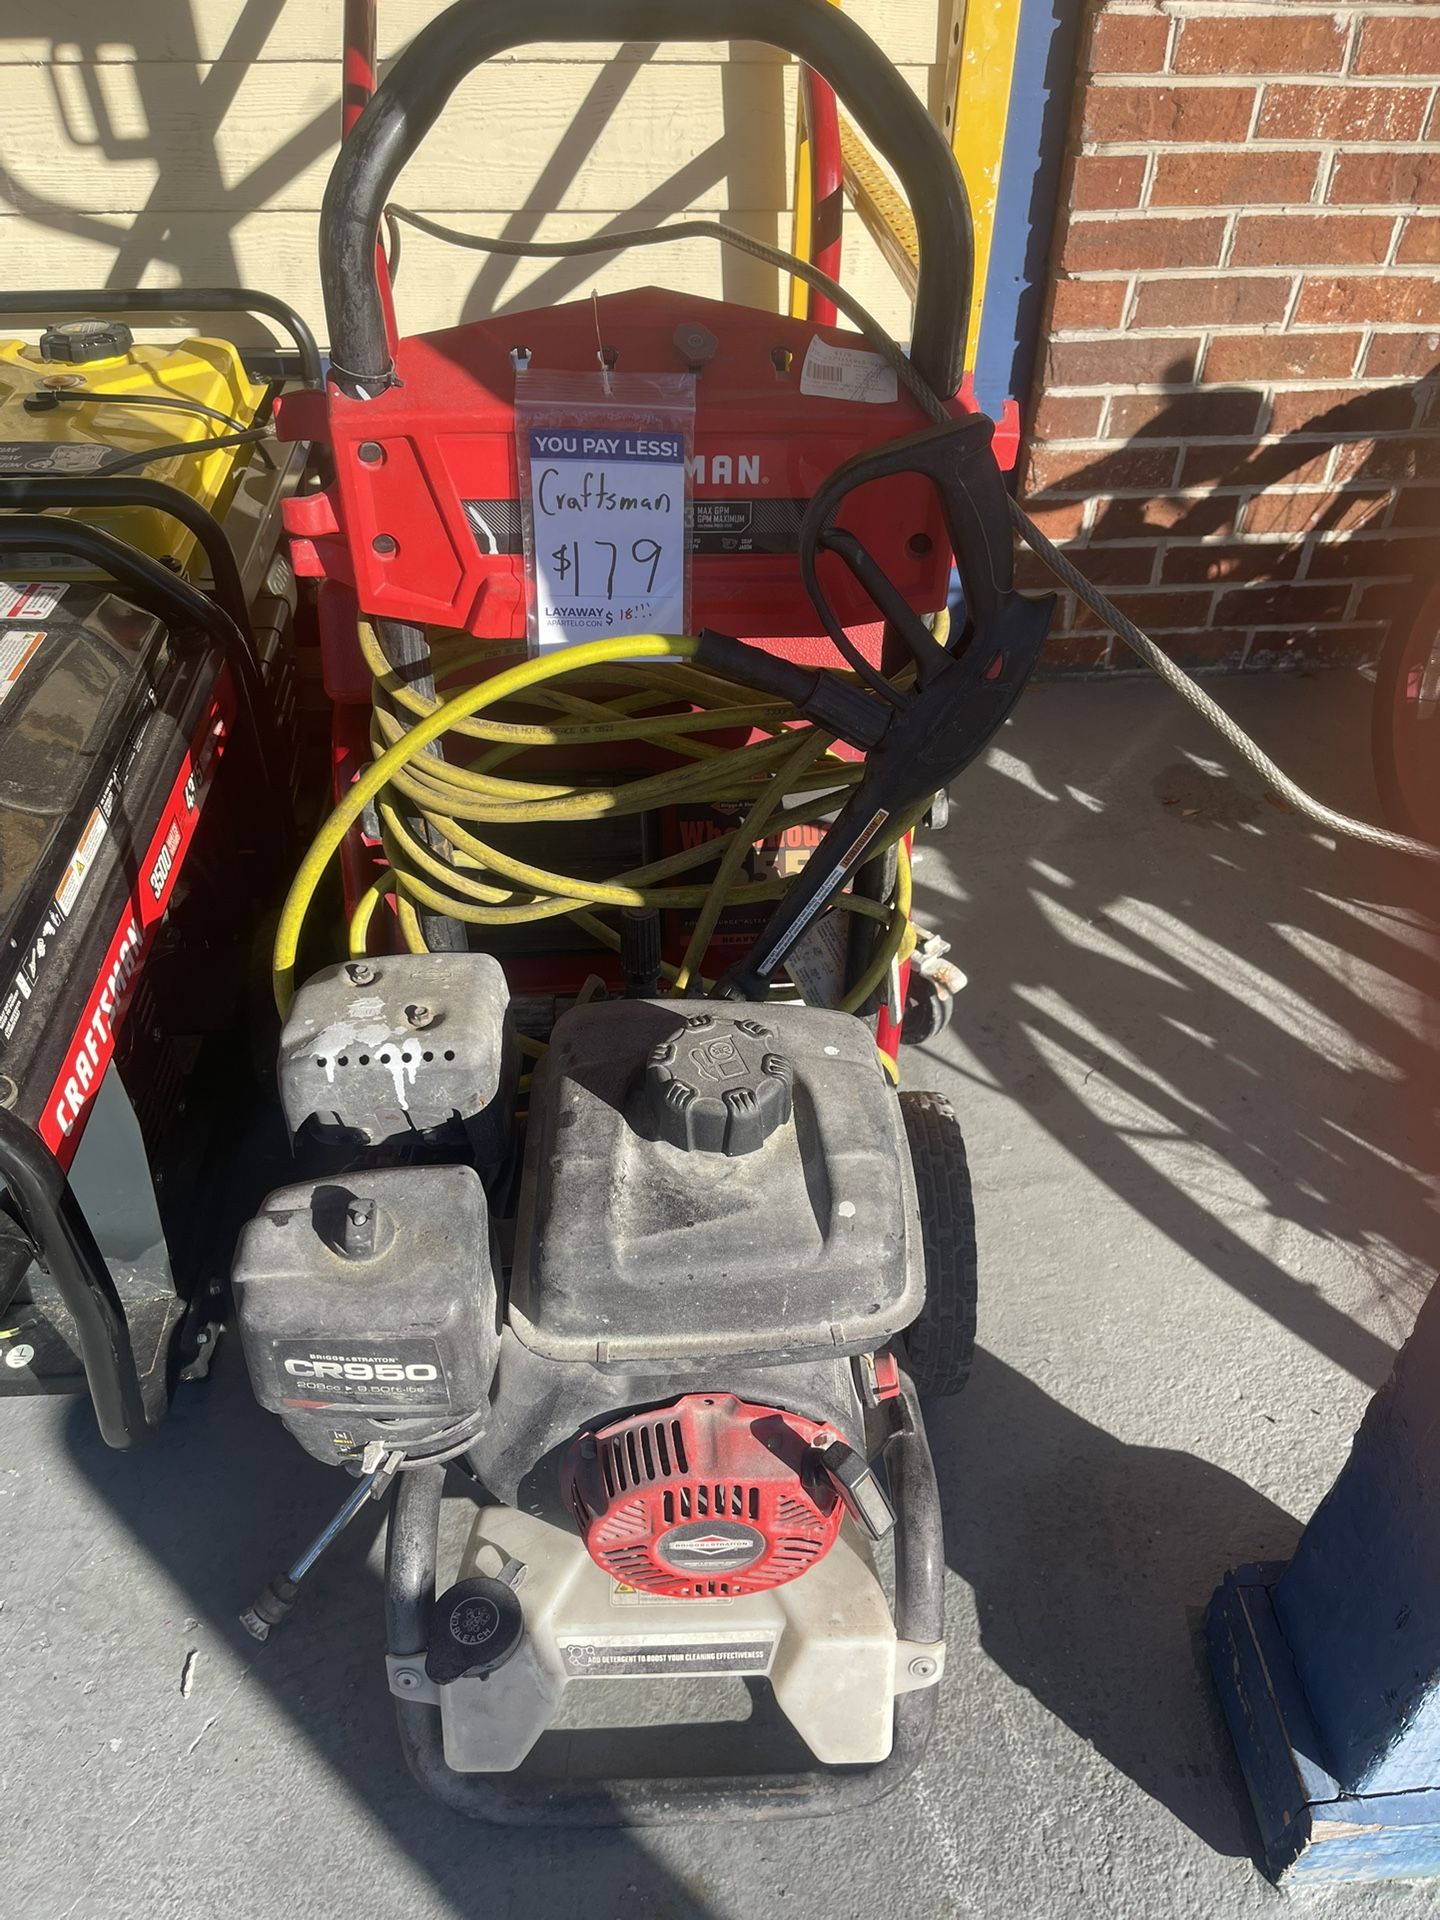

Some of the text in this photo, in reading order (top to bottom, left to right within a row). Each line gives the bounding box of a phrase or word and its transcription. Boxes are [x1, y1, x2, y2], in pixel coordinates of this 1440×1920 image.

[535, 436, 678, 457] YOU PAY LESS!
[538, 467, 671, 516] Craftsman
[697, 506, 730, 515] MAX GPM
[697, 515, 745, 523] GPM MAXIMUM
[551, 538, 663, 600] $179
[545, 607, 604, 617] LAYAWAY
[605, 611, 613, 626] $
[585, 620, 603, 628] CON
[149, 843, 173, 900] 3500
[55, 917, 145, 1138] CRAFTSMAN
[283, 1359, 438, 1382] CR950
[296, 1381, 341, 1391] 208cc
[453, 1626, 491, 1642] BLEACH
[588, 1651, 764, 1664] ADD DETERGENT TO BOOST YOUR CLEANING EFFECTIVENESS
